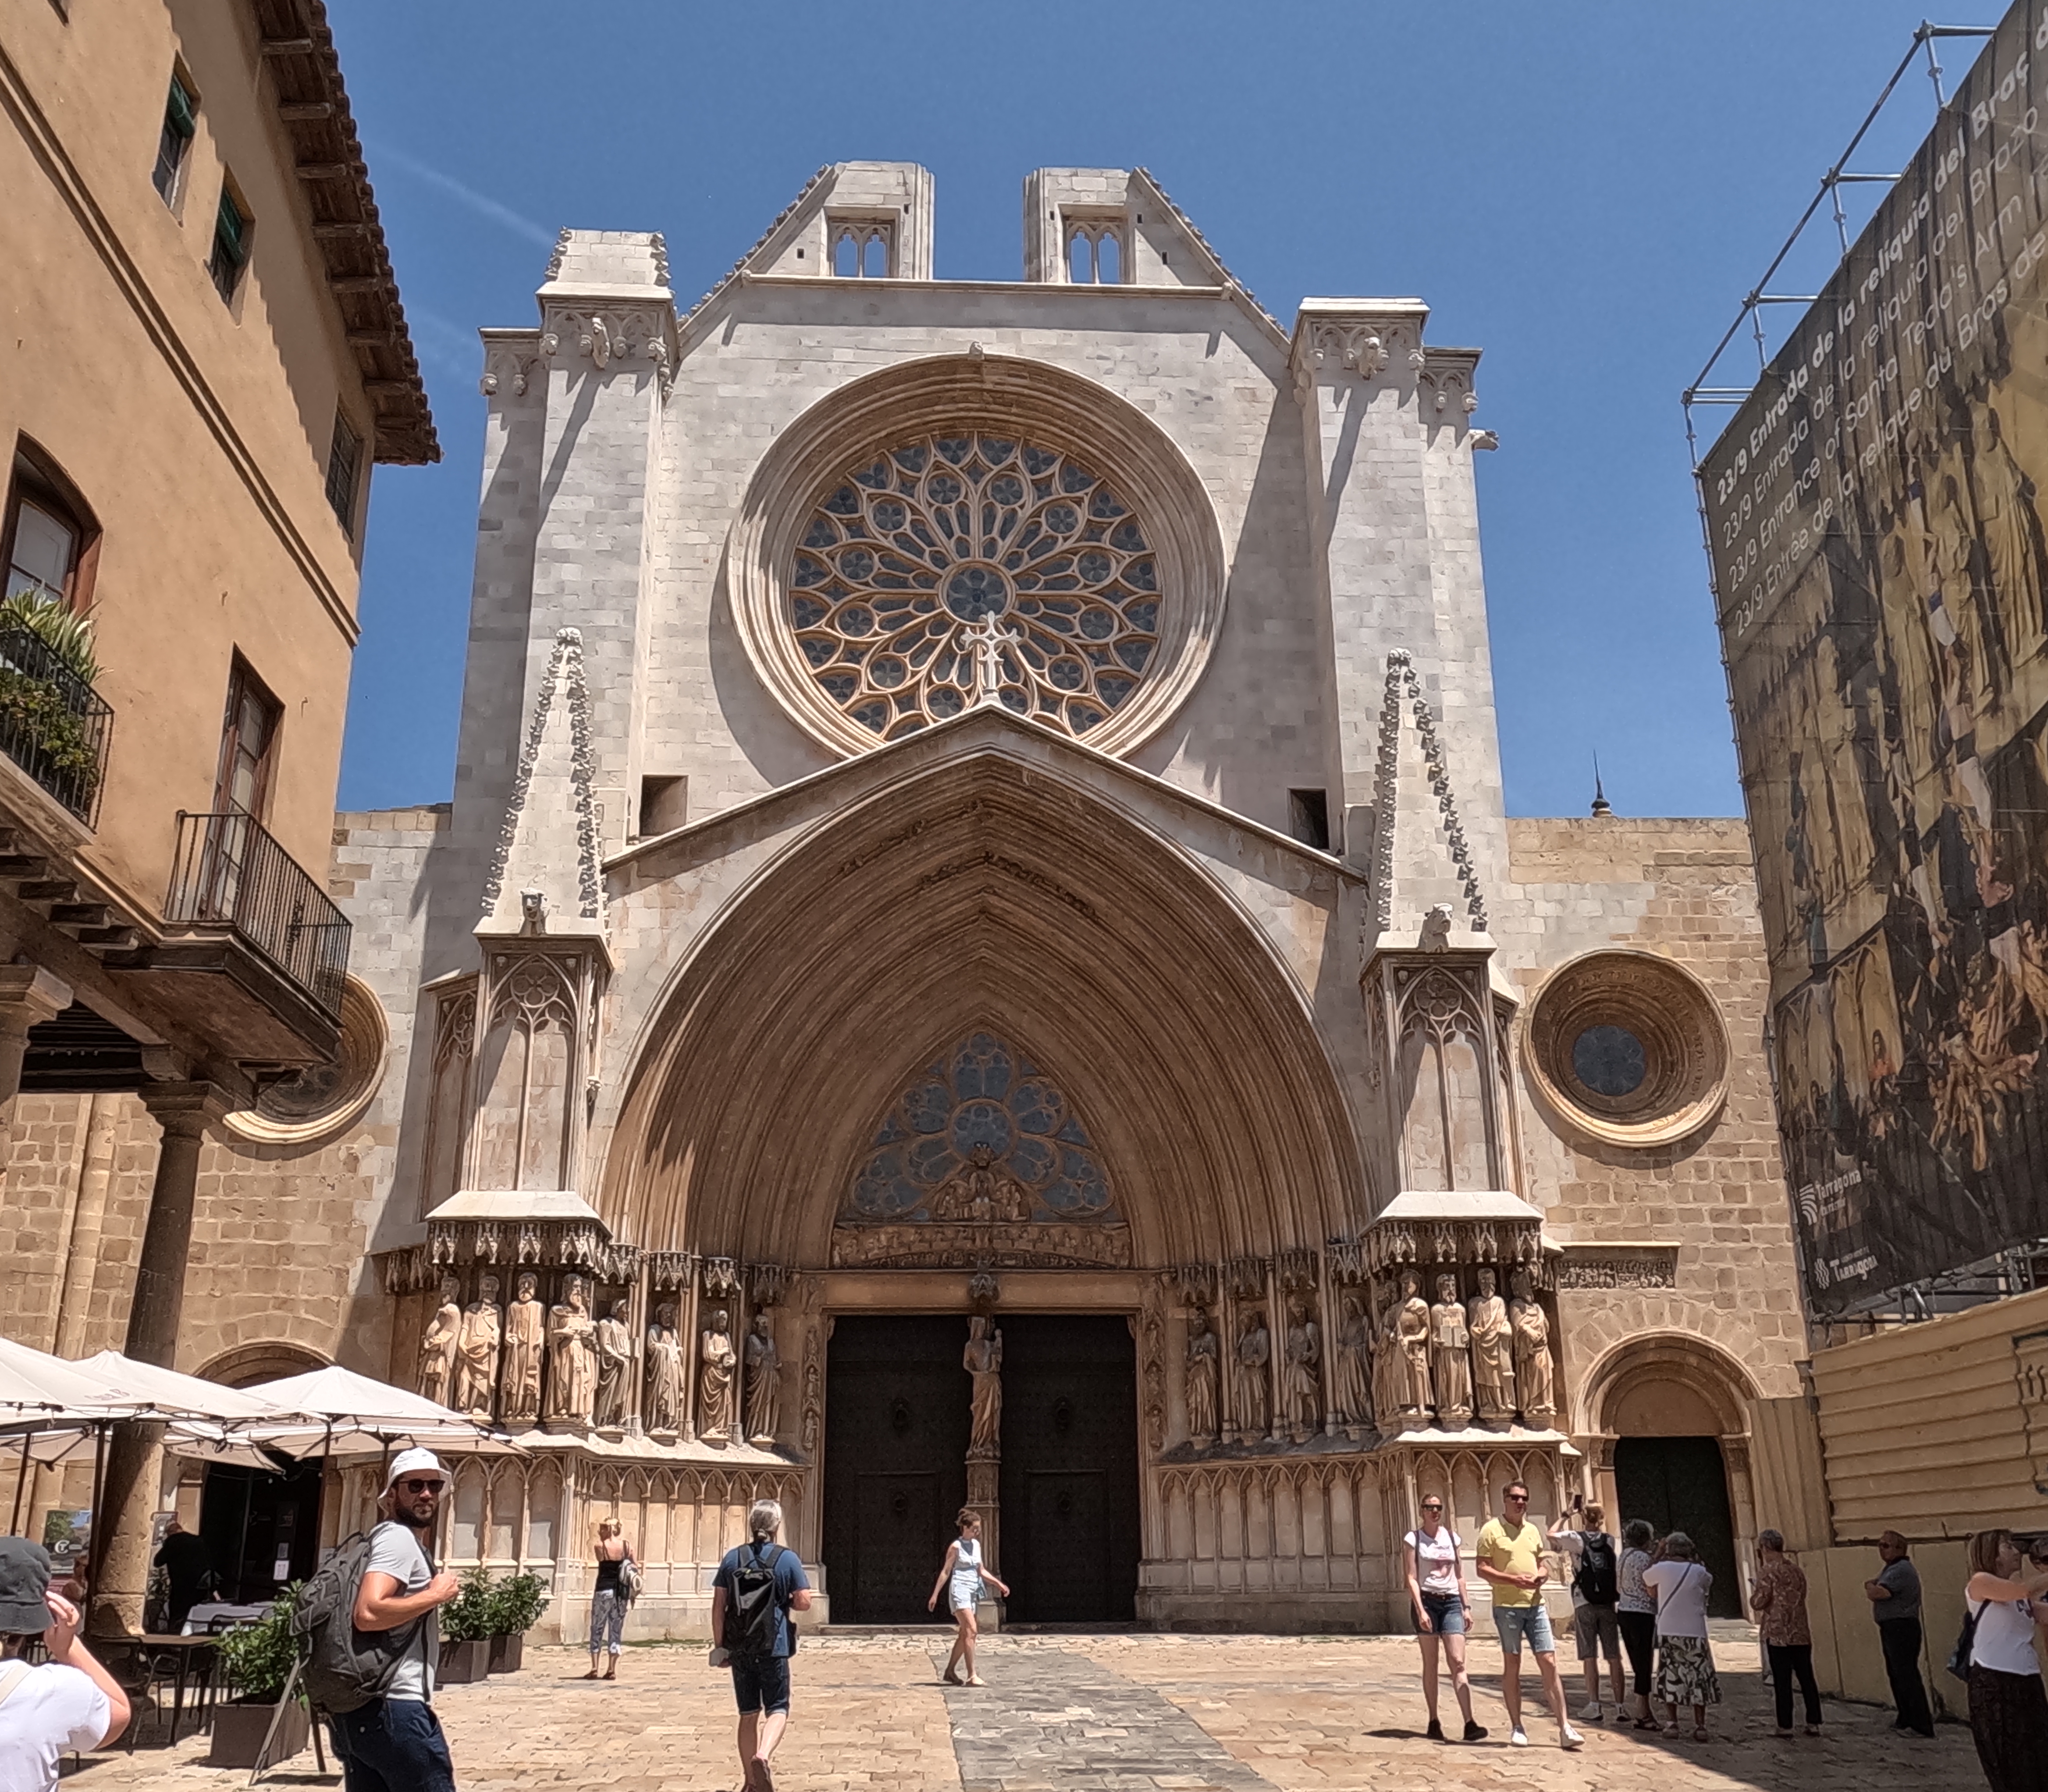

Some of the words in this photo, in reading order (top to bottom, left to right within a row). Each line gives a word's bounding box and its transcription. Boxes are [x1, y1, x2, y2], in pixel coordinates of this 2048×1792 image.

[1718, 448, 1747, 506] 23/9
[1750, 364, 1809, 459] Entrada
[1813, 331, 1834, 368] de
[1838, 299, 1855, 335] la
[1860, 191, 1930, 305] reliquia
[1935, 127, 1966, 193] del
[1971, 51, 2029, 140] Braç
[1723, 493, 1752, 548] 23/9
[1754, 416, 1809, 504] Entrada
[1814, 384, 1834, 420] de
[1839, 354, 1855, 387] la
[1861, 254, 1927, 358] reliquia
[1933, 193, 1963, 256] del
[1969, 106, 2038, 206] Brazo
[1729, 538, 1757, 592] 23/9
[1760, 457, 1820, 550] Entrance
[1825, 417, 1841, 460] of
[1846, 355, 1898, 432] Santa
[1902, 264, 1967, 356] Tecla's
[1975, 195, 2021, 267] Arm
[1735, 583, 1763, 637] 23/9
[1766, 528, 1809, 595] Entrée
[1813, 497, 1833, 532] de
[1837, 470, 1854, 503] la
[1859, 388, 1921, 477] relique
[1926, 346, 1951, 389] du
[1958, 278, 2008, 351] Bras
[2016, 231, 2046, 279] de
